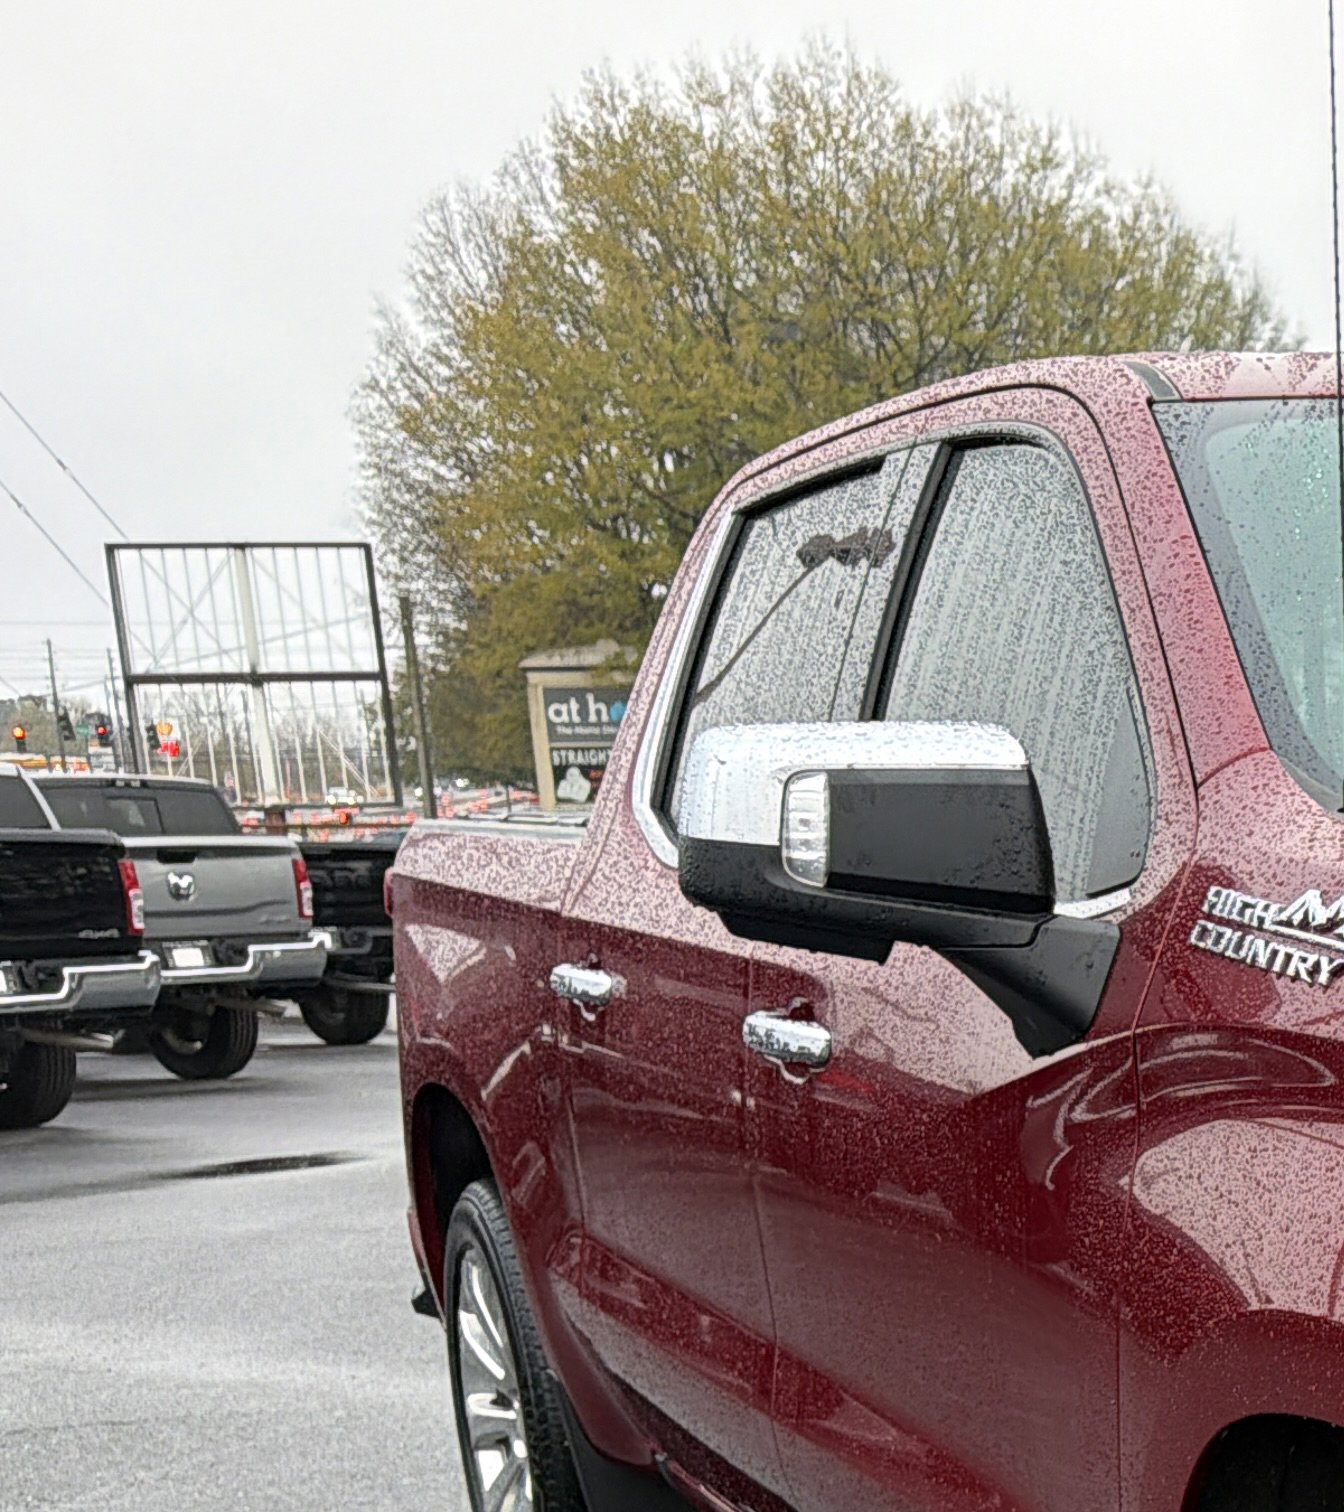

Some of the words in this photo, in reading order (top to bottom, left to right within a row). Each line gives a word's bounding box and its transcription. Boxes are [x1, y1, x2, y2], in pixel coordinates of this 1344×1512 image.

[548, 697, 582, 724] at
[586, 692, 627, 724] ho
[1201, 886, 1279, 928] HIGH
